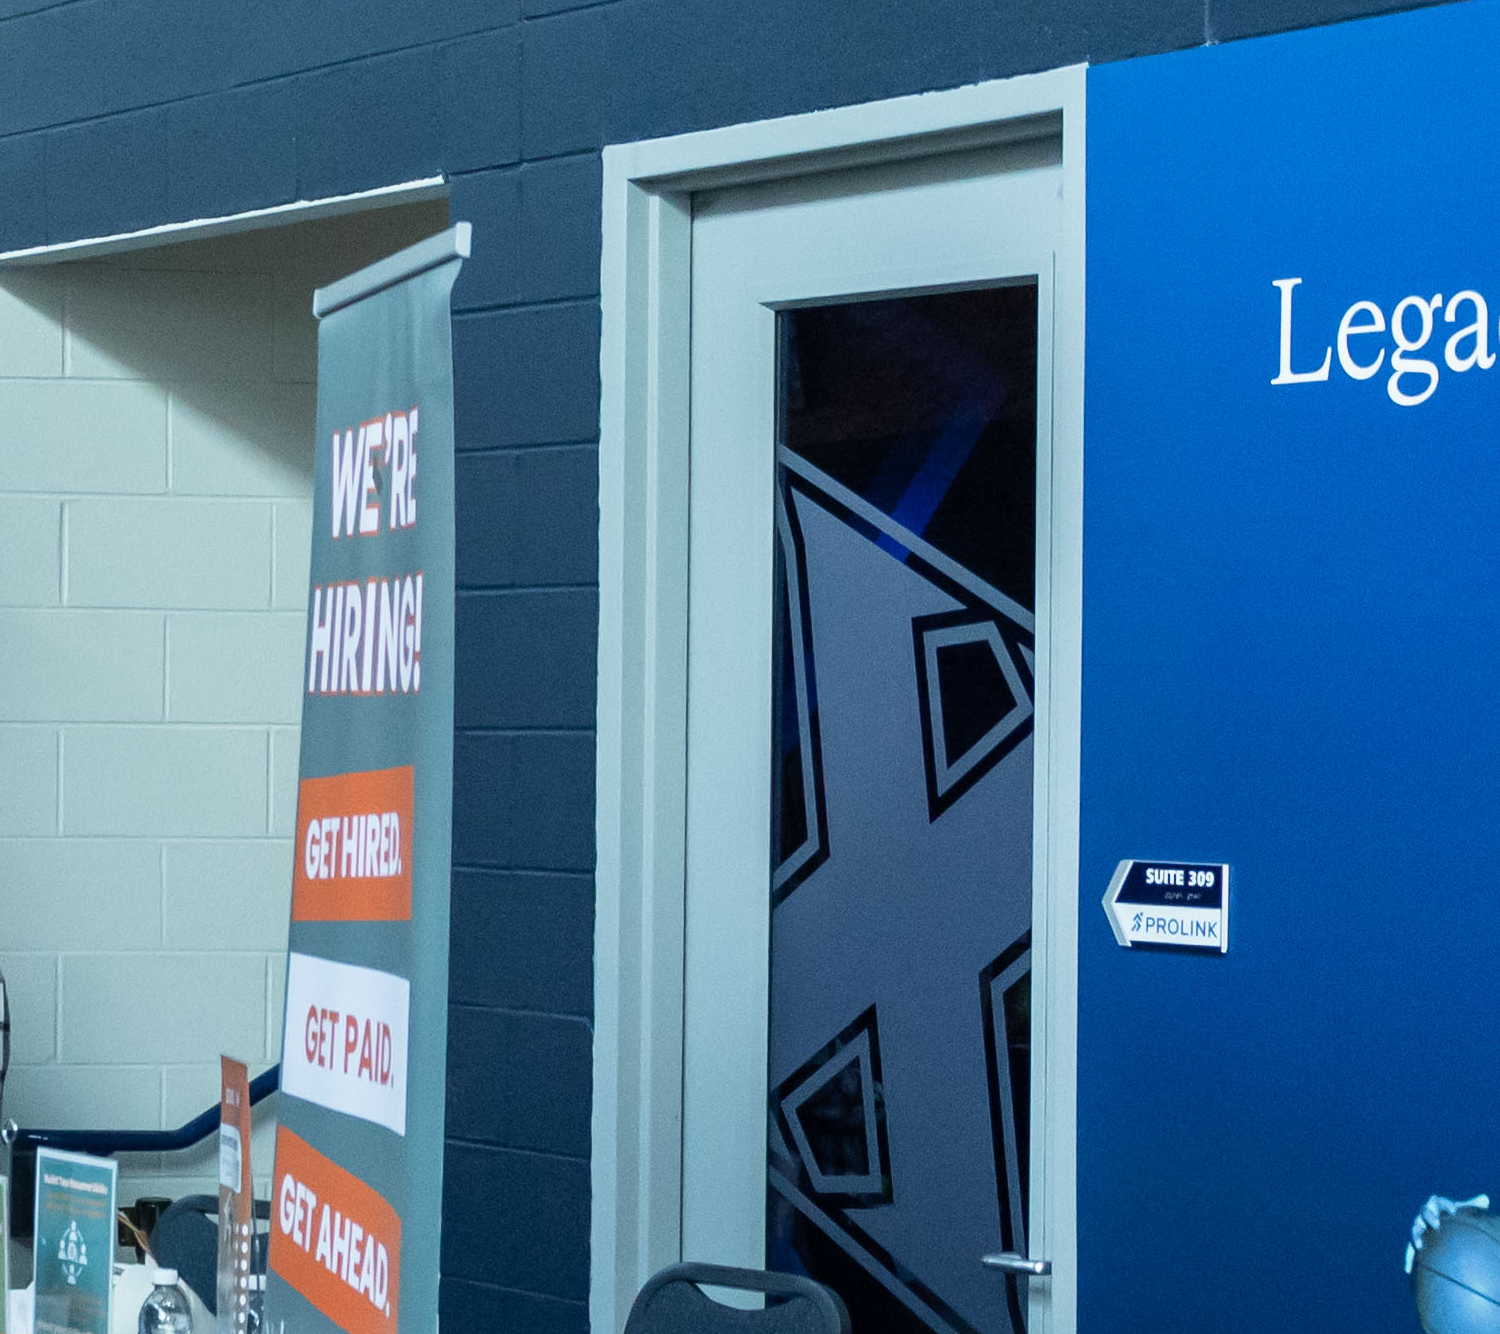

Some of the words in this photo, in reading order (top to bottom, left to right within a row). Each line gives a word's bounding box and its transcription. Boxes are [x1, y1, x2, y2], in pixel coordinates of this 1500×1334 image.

[1270, 277, 1500, 406] Lega
[331, 405, 420, 539] WE'RE
[308, 571, 424, 695] HIRING!
[304, 814, 339, 880] GET
[341, 811, 402, 879] HIRED.
[1145, 868, 1185, 886] SUITE
[1187, 870, 1215, 887] 309
[1145, 916, 1218, 939] PROLINK
[304, 1004, 340, 1070] GET
[343, 1014, 395, 1088] PAID.
[278, 1173, 318, 1253] GET
[315, 1203, 391, 1320] AHEAD.
